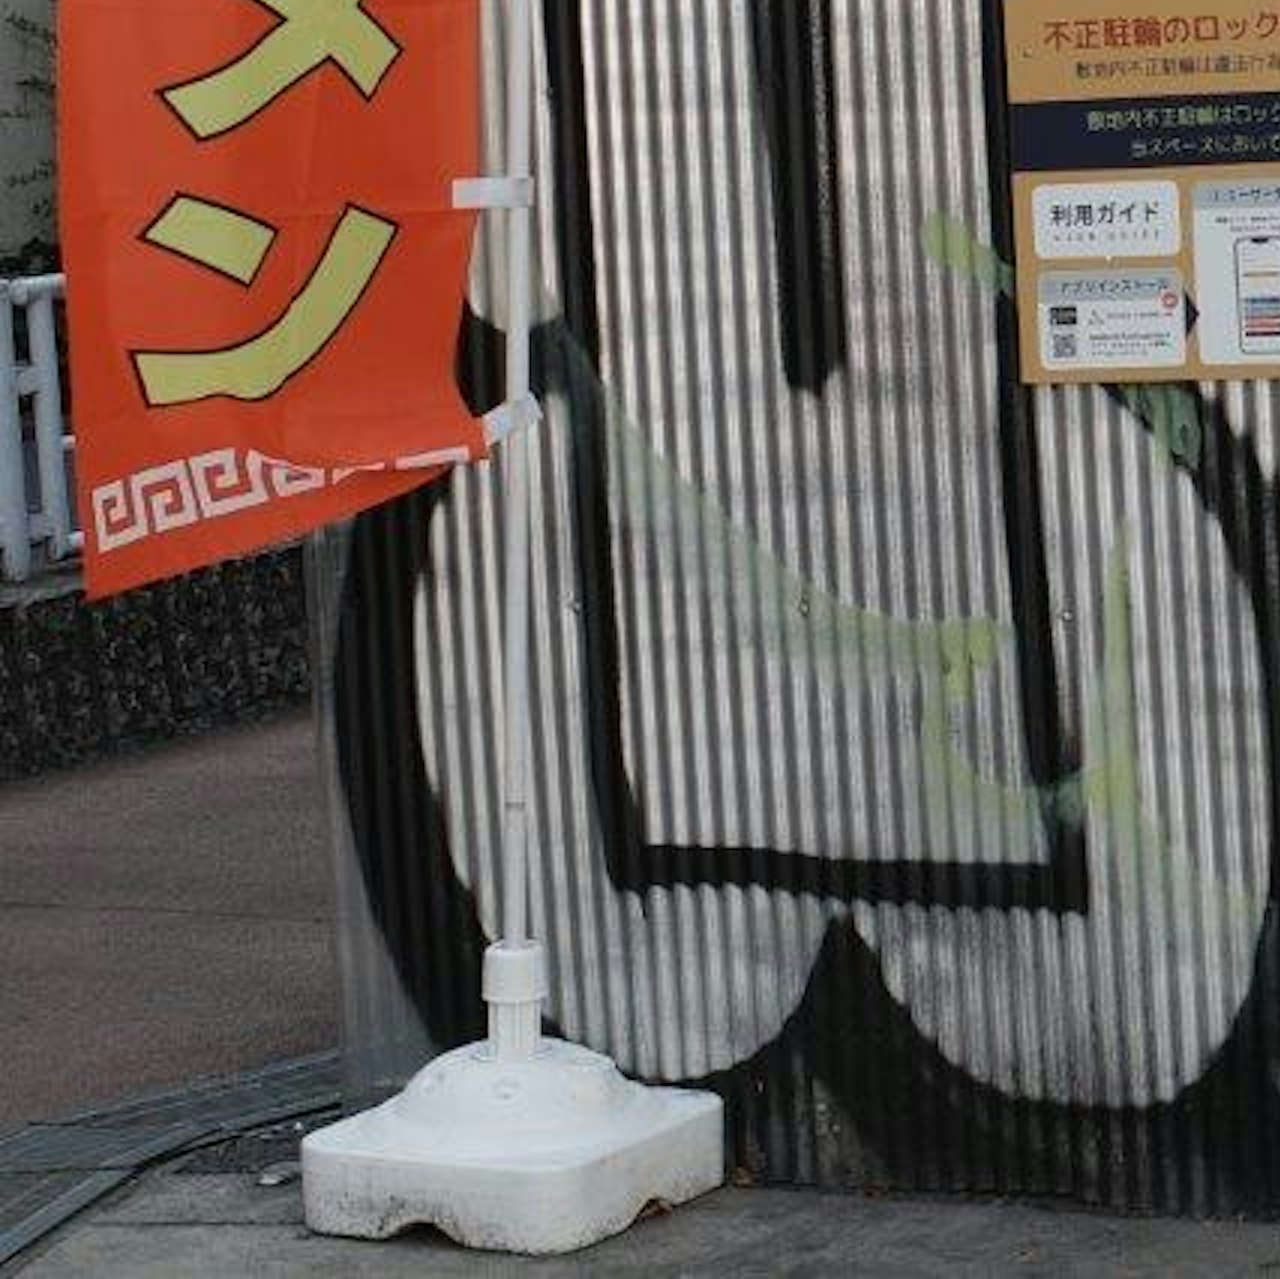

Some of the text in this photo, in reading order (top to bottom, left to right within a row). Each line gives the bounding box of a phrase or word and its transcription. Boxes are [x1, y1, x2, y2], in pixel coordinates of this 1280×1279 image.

[1050, 201, 1161, 227] 利用ガイド
